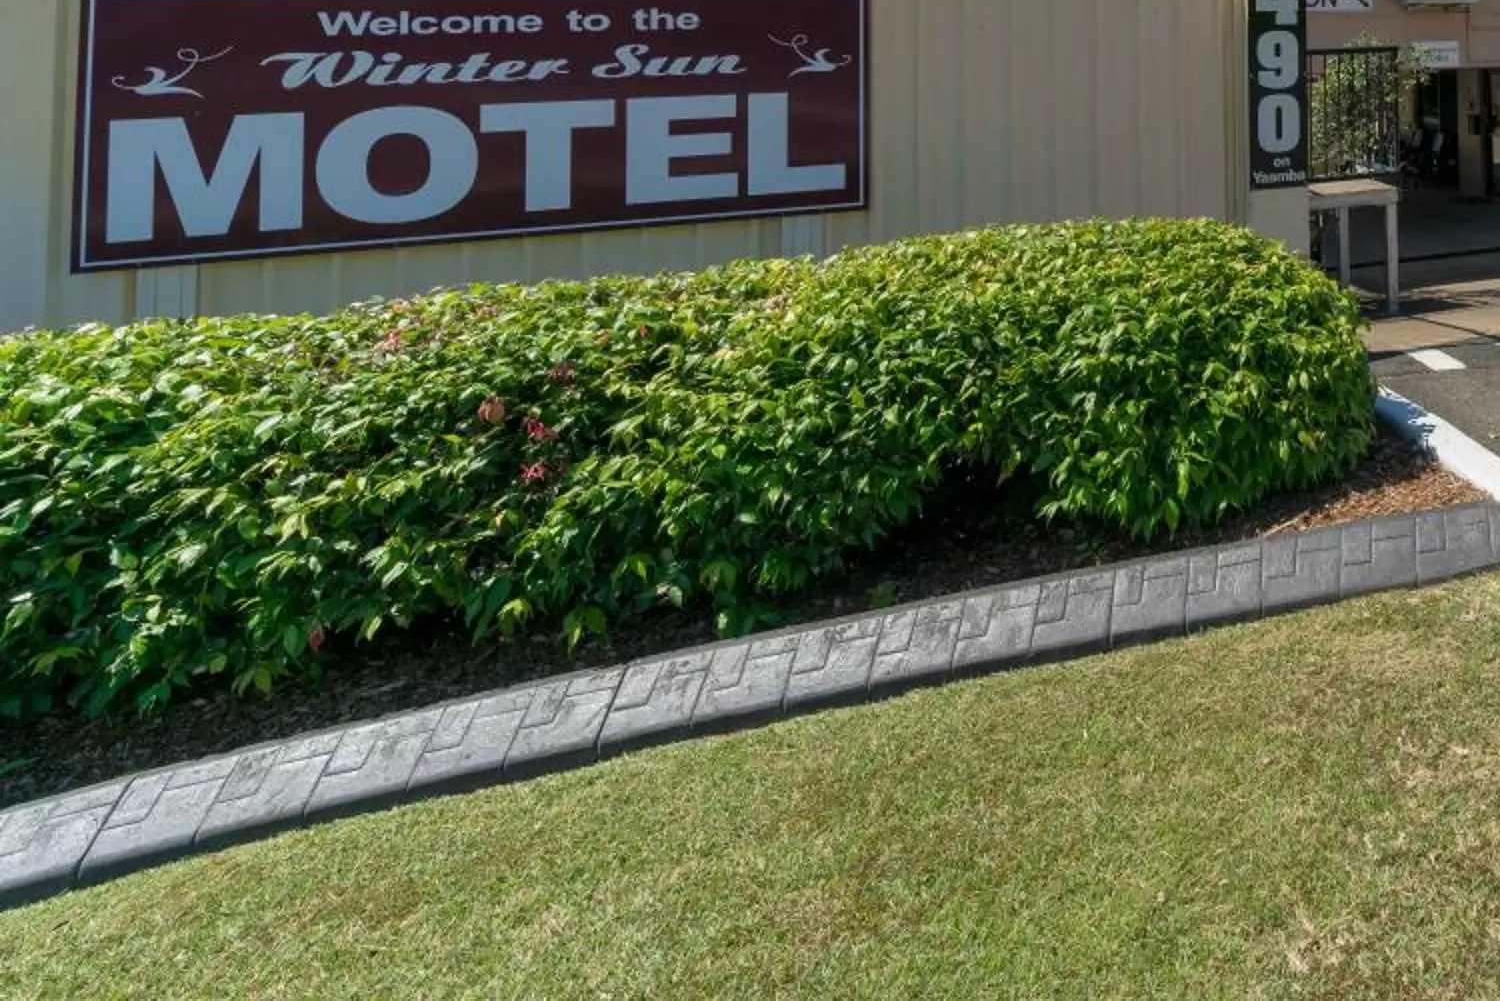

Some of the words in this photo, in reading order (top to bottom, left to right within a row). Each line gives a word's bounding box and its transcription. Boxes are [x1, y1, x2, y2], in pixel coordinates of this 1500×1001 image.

[317, 10, 543, 38] Welcome
[567, 9, 611, 33] to
[633, 7, 701, 33] the
[260, 50, 570, 89] Winter
[592, 43, 747, 79] Sun
[105, 91, 847, 245] MOTEL
[1273, 157, 1292, 168] on
